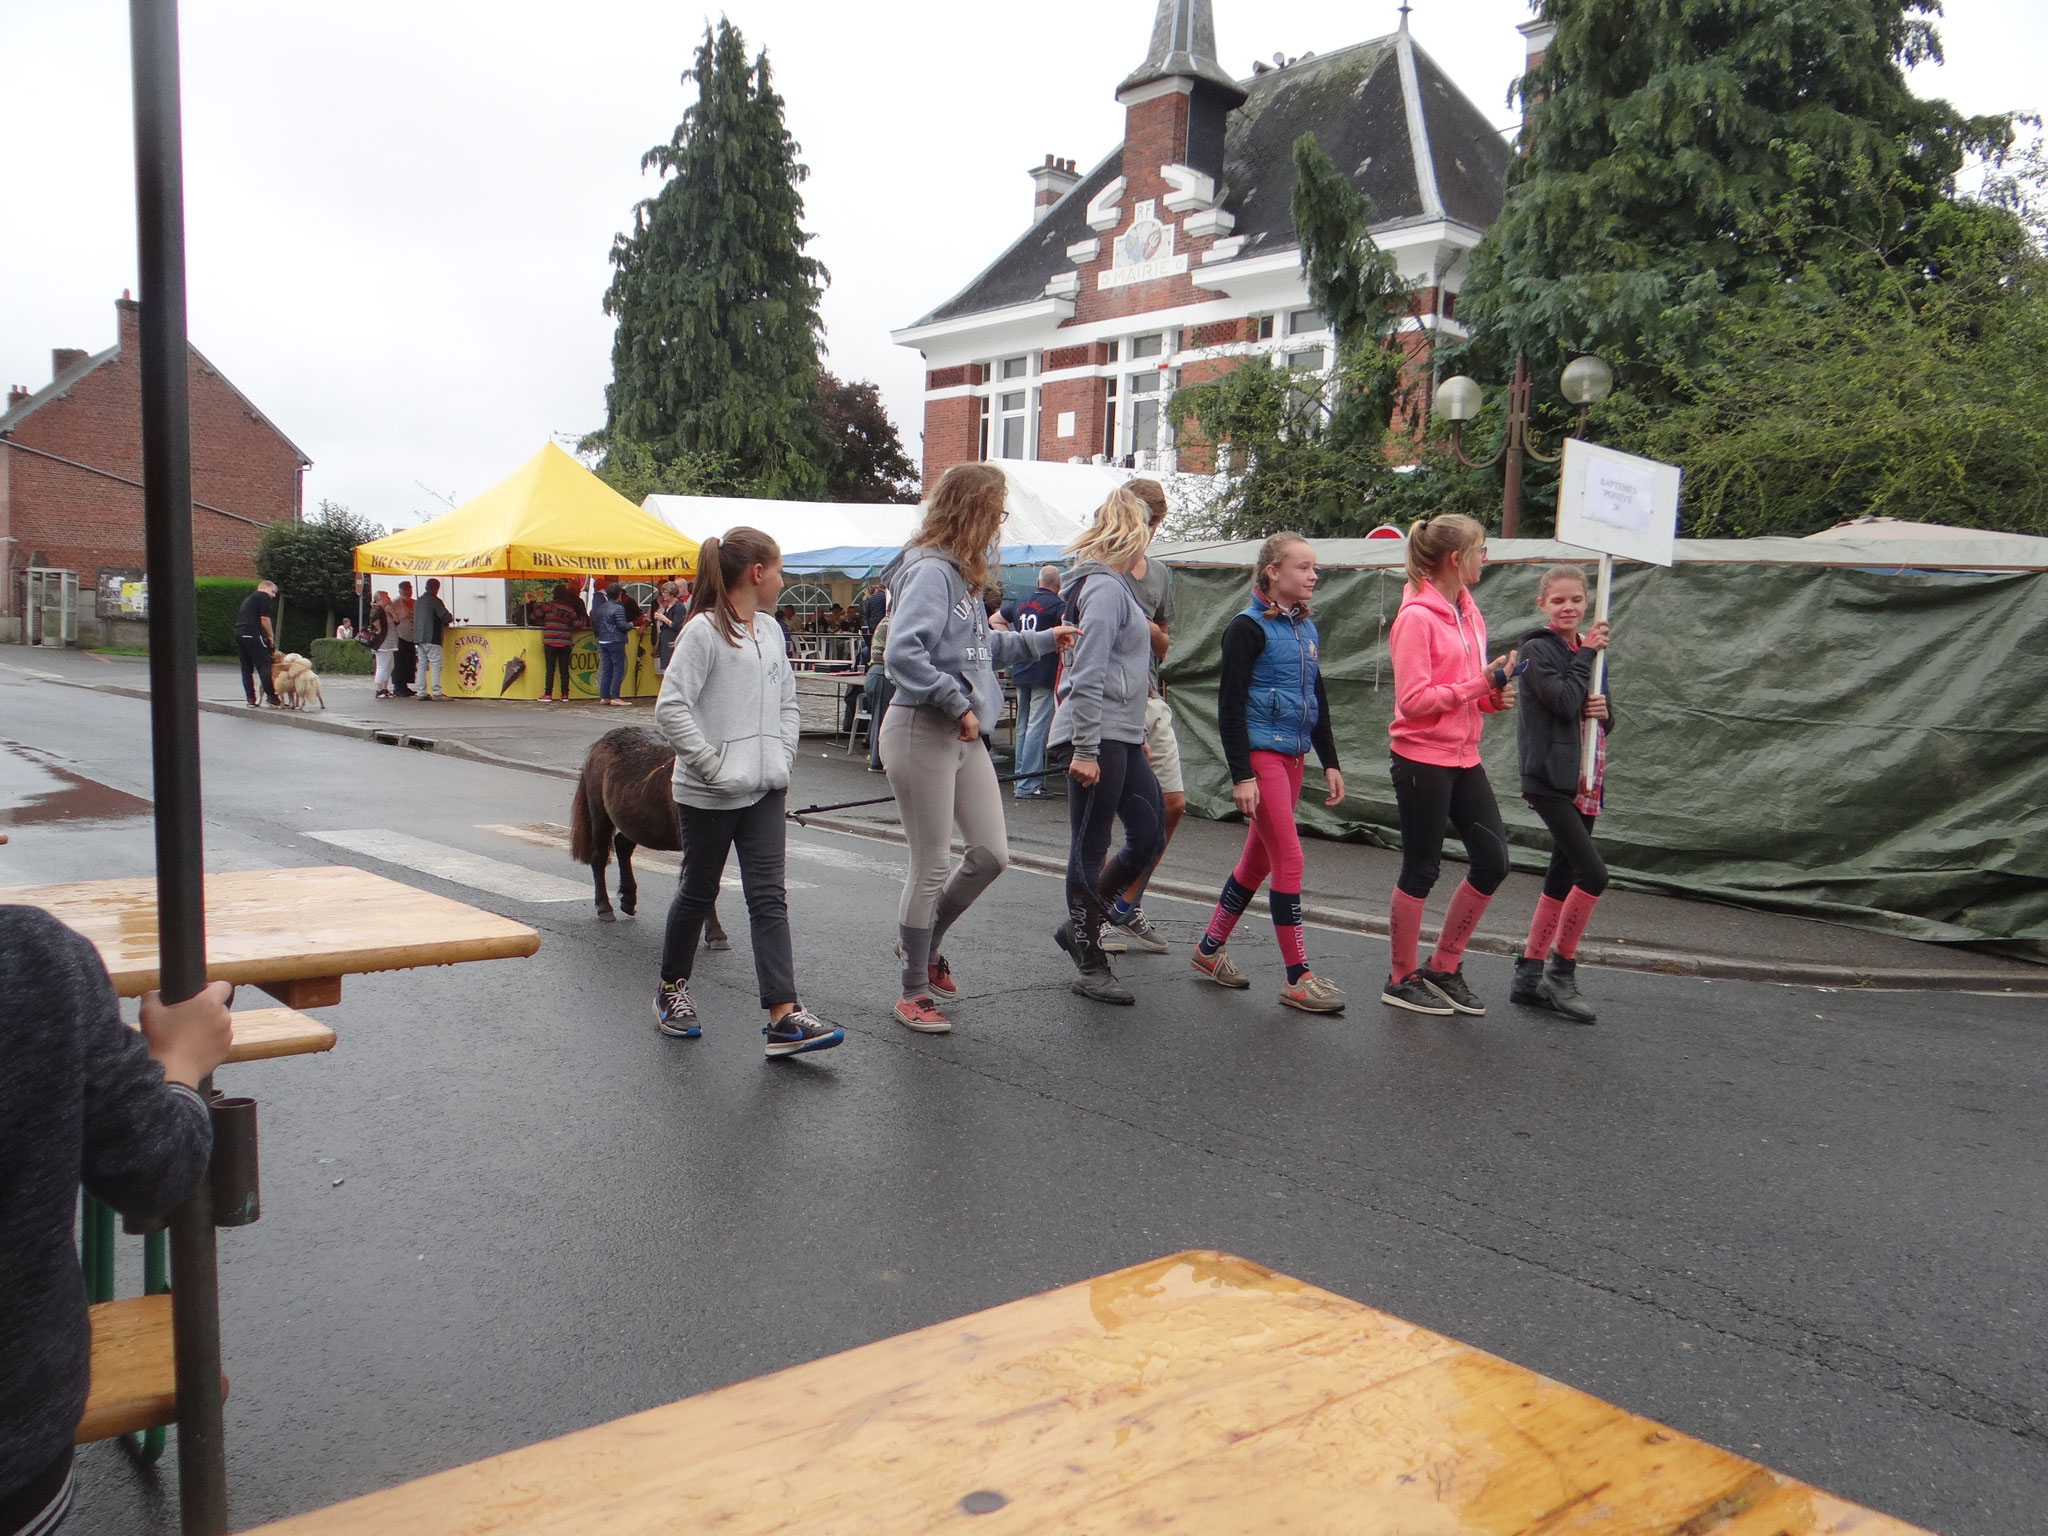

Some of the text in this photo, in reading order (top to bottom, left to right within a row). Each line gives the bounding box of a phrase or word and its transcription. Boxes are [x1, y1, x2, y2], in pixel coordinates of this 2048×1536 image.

[1114, 260, 1169, 282] MAIRIE
[371, 554, 434, 571] BRASSERIE
[435, 560, 450, 571] DE
[533, 552, 690, 570] BRASSERIE DE CLERCK
[1018, 613, 1037, 631] 10
[455, 635, 489, 649] STAGER
[1206, 886, 1244, 948] KINGSLAND
